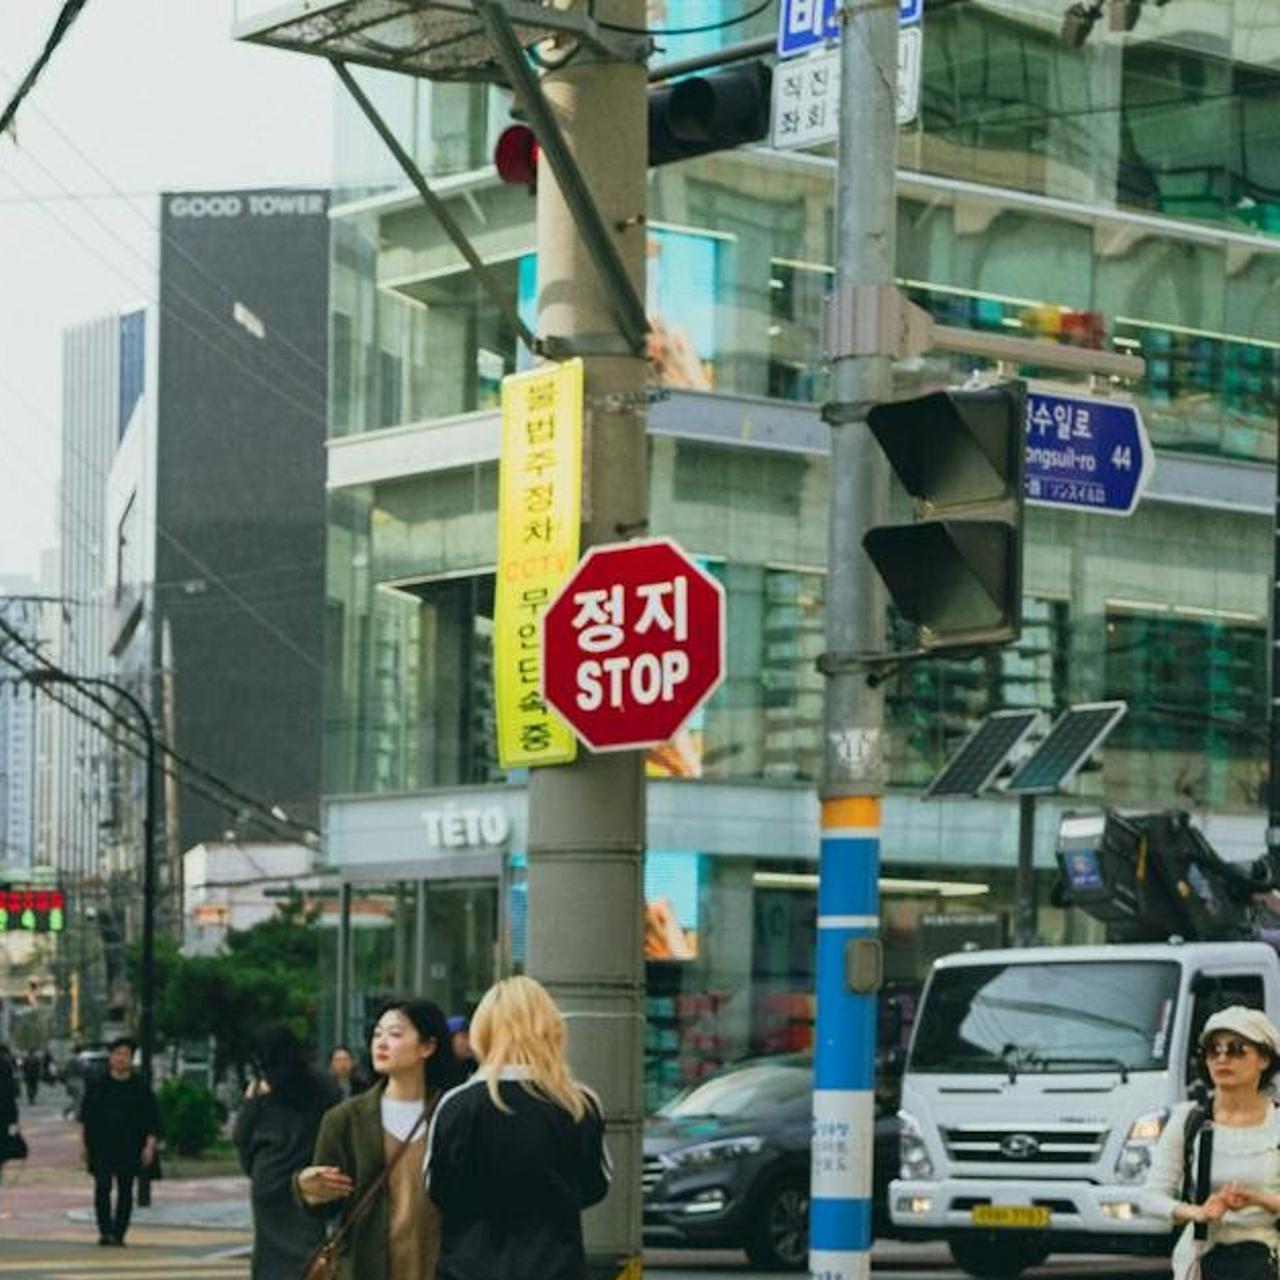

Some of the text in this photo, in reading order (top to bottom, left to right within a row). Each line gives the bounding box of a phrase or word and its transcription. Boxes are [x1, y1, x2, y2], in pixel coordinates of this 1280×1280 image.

[169, 194, 324, 218] GOOD TOWER
[1026, 445, 1132, 473] ongsuil-ro 44
[506, 557, 568, 583] CCTV
[572, 575, 689, 653] 정지
[575, 651, 691, 712] STOP
